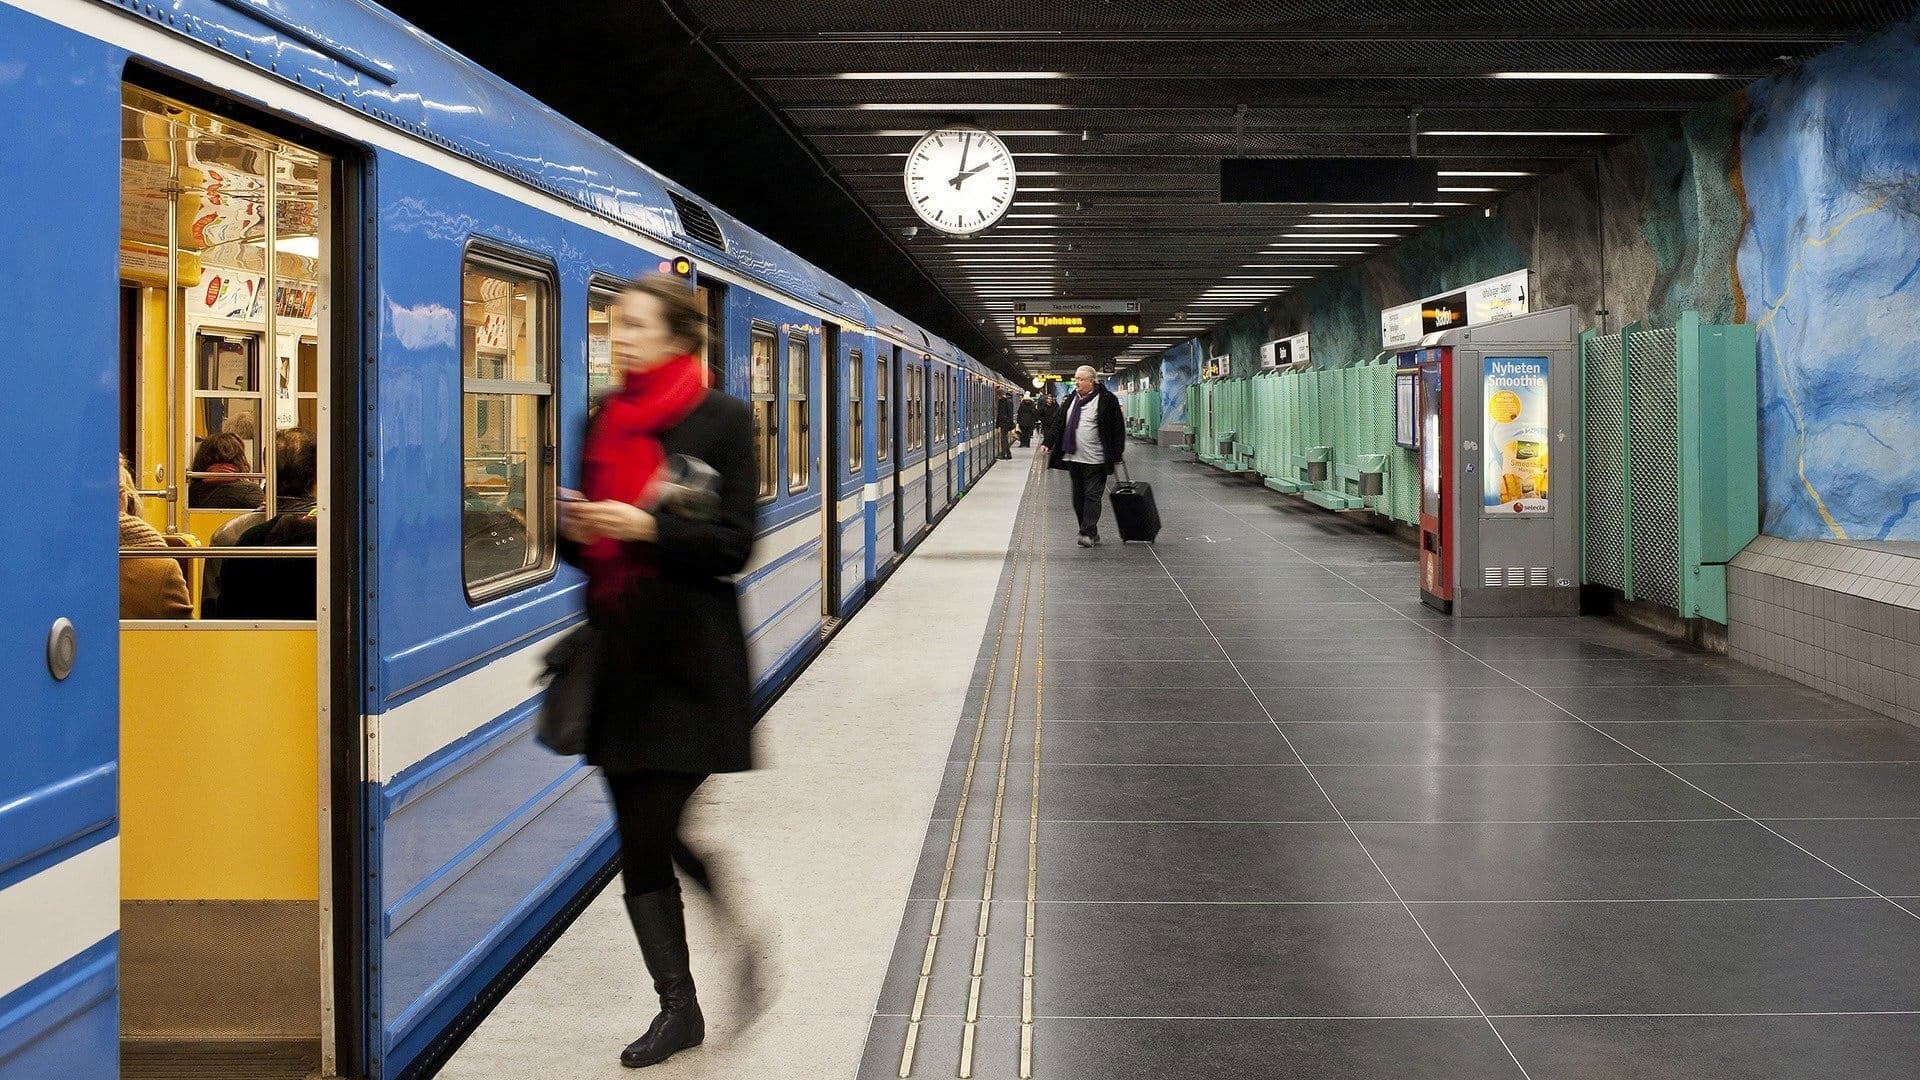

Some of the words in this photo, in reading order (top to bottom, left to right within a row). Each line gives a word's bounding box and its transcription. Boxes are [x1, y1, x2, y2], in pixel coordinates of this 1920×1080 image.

[1016, 317, 1026, 325] 14
[1492, 362, 1540, 376] Nyheten
[1488, 375, 1544, 387] Smoothie
[1524, 503, 1545, 511] selecta
